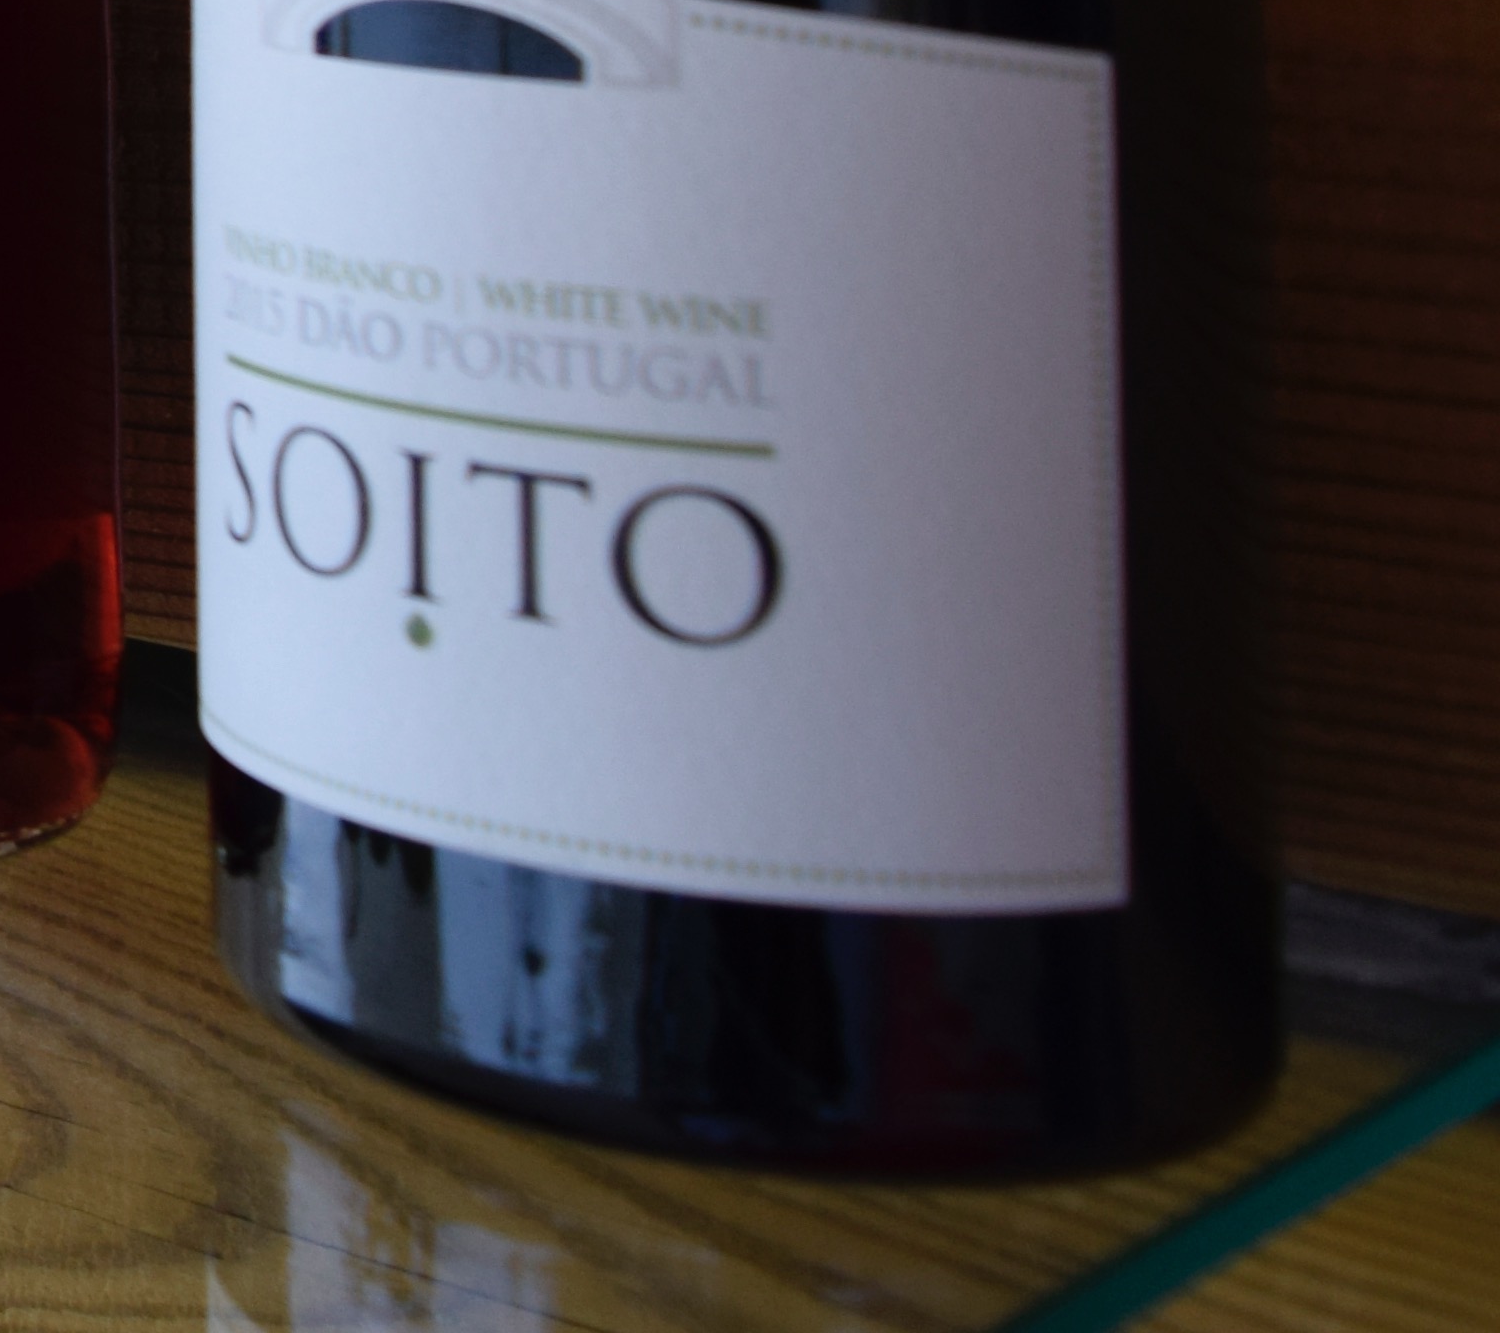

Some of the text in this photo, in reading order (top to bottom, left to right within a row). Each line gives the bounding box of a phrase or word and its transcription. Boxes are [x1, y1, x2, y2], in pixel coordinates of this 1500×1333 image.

[476, 273, 624, 329] WHITE
[637, 289, 772, 340] WINE
[422, 319, 774, 410] PORTUGAL
[225, 400, 784, 648] SOITO
